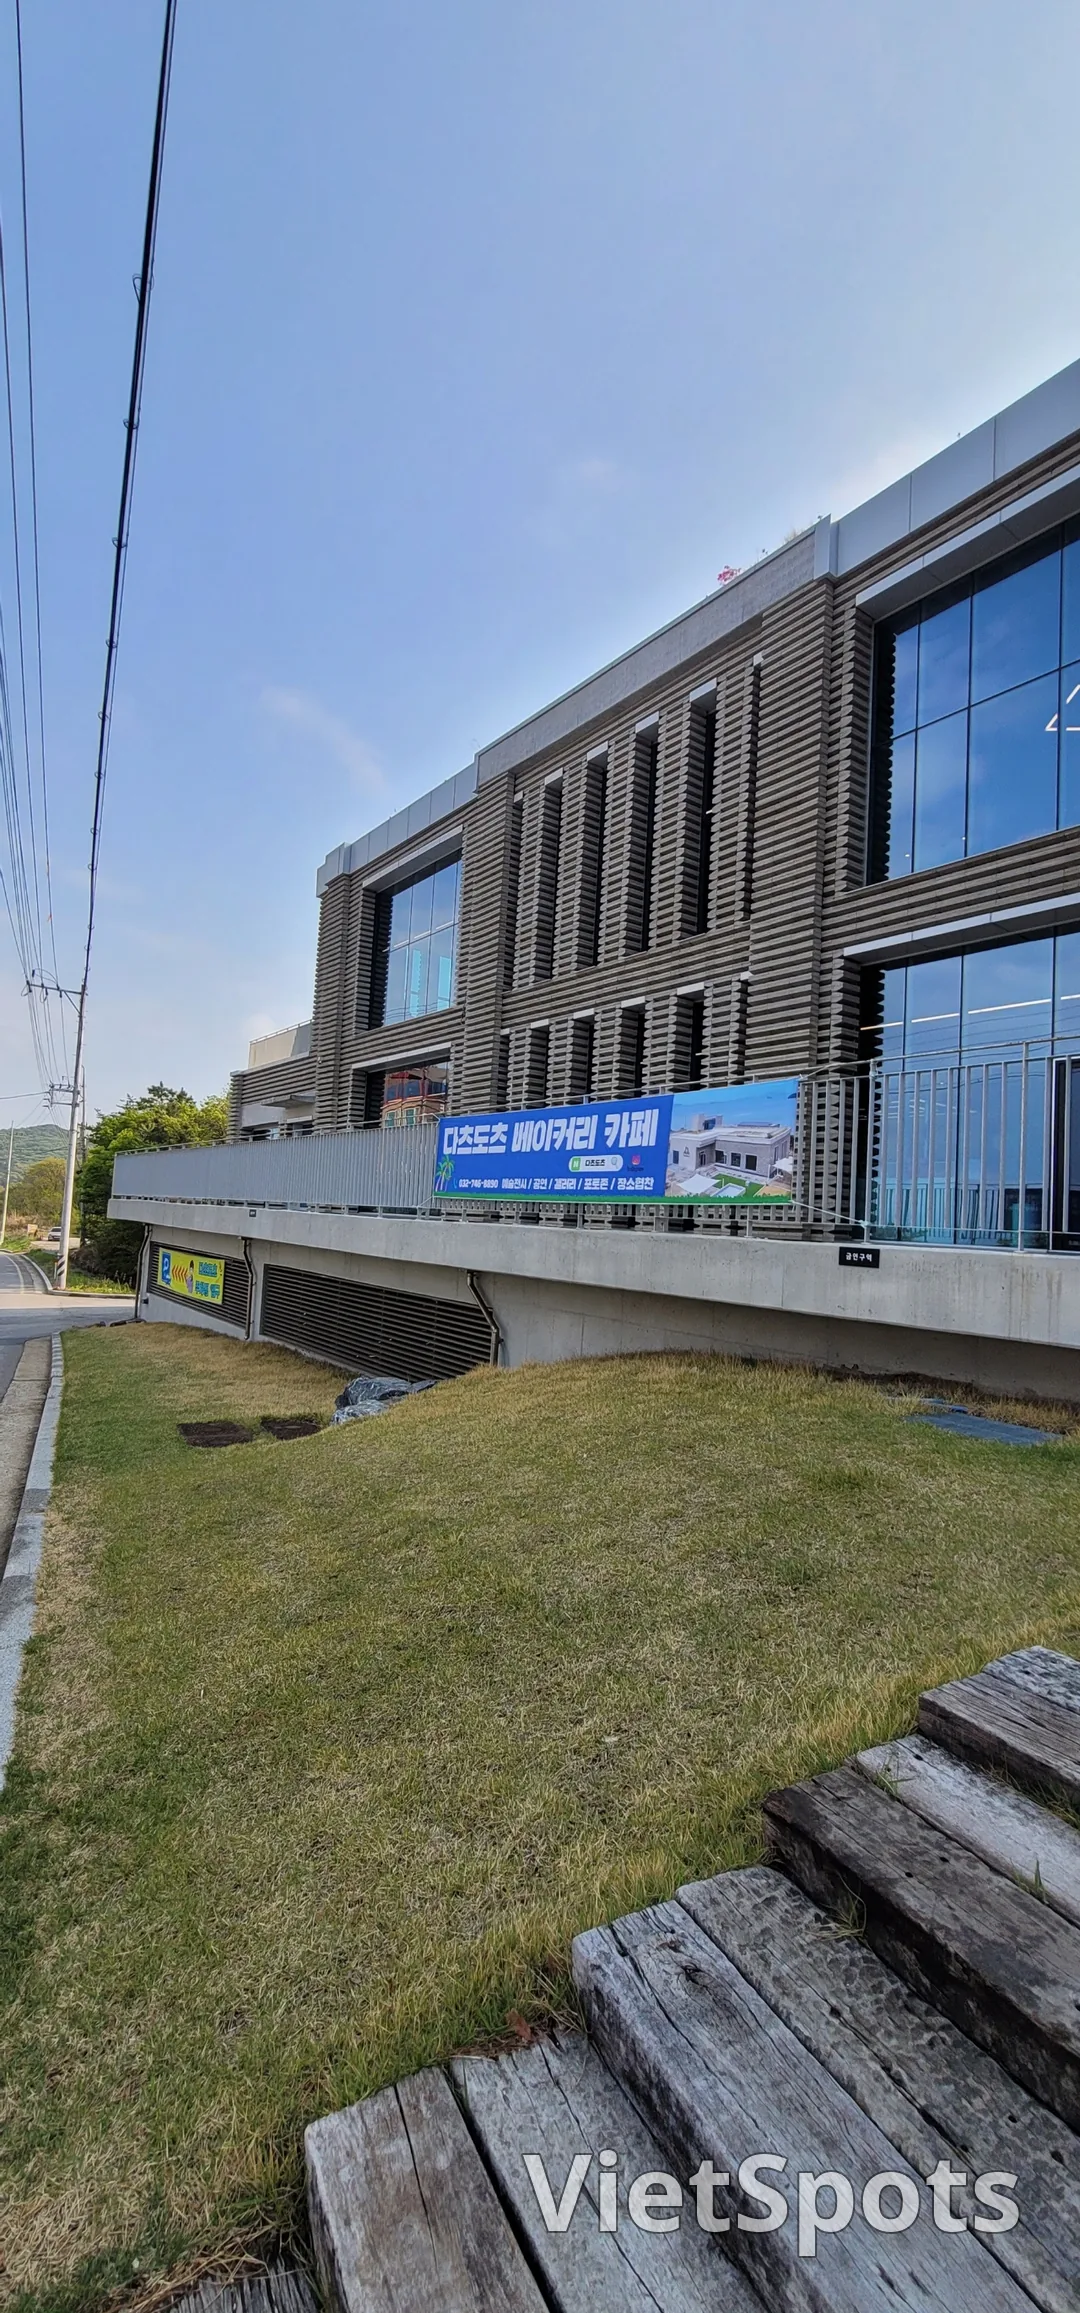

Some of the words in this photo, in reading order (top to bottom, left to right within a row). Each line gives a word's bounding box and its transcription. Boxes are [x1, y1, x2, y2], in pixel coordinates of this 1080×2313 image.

[443, 1123, 509, 1154] 다츠도츠
[511, 1115, 598, 1152] 베이커리
[604, 1109, 659, 1148] 카페
[585, 1159, 605, 1167] 다츠도츠
[502, 1178, 527, 1190] 예술전시
[533, 1178, 548, 1190] 공연
[554, 1178, 576, 1190] 갤러리
[584, 1178, 609, 1190] 포토존
[617, 1177, 655, 1190] 장소협찬
[846, 1252, 872, 1262] 금연구역
